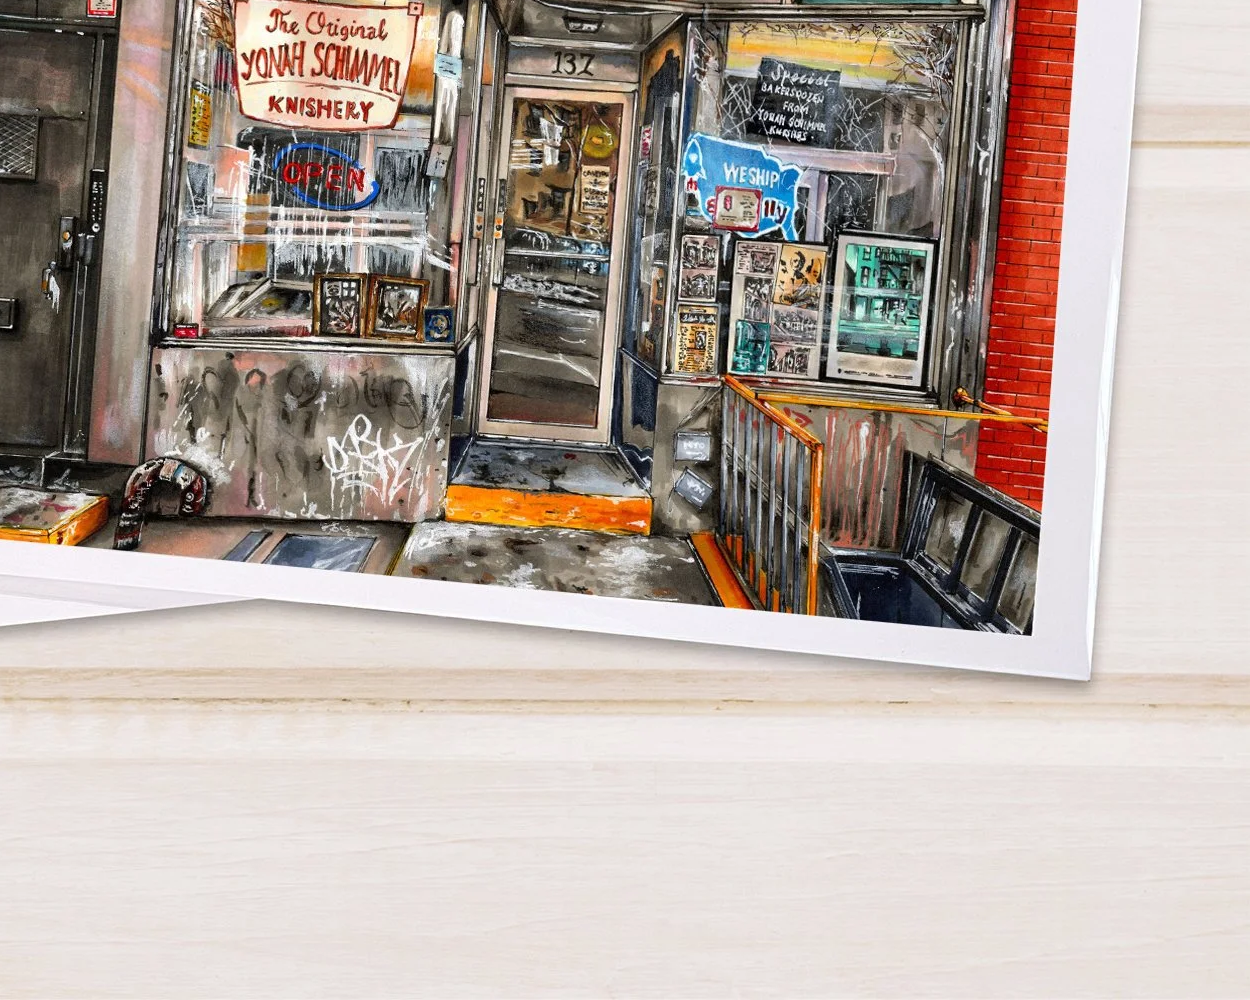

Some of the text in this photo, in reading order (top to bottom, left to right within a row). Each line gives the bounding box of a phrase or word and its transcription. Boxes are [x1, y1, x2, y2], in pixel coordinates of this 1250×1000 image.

[265, 7, 389, 42] The Original
[240, 40, 403, 96] YONAH SCHIMMEL
[551, 50, 596, 77] 137
[770, 62, 832, 87] Special
[268, 95, 375, 125] KNISHERY
[282, 161, 366, 193] OPEN
